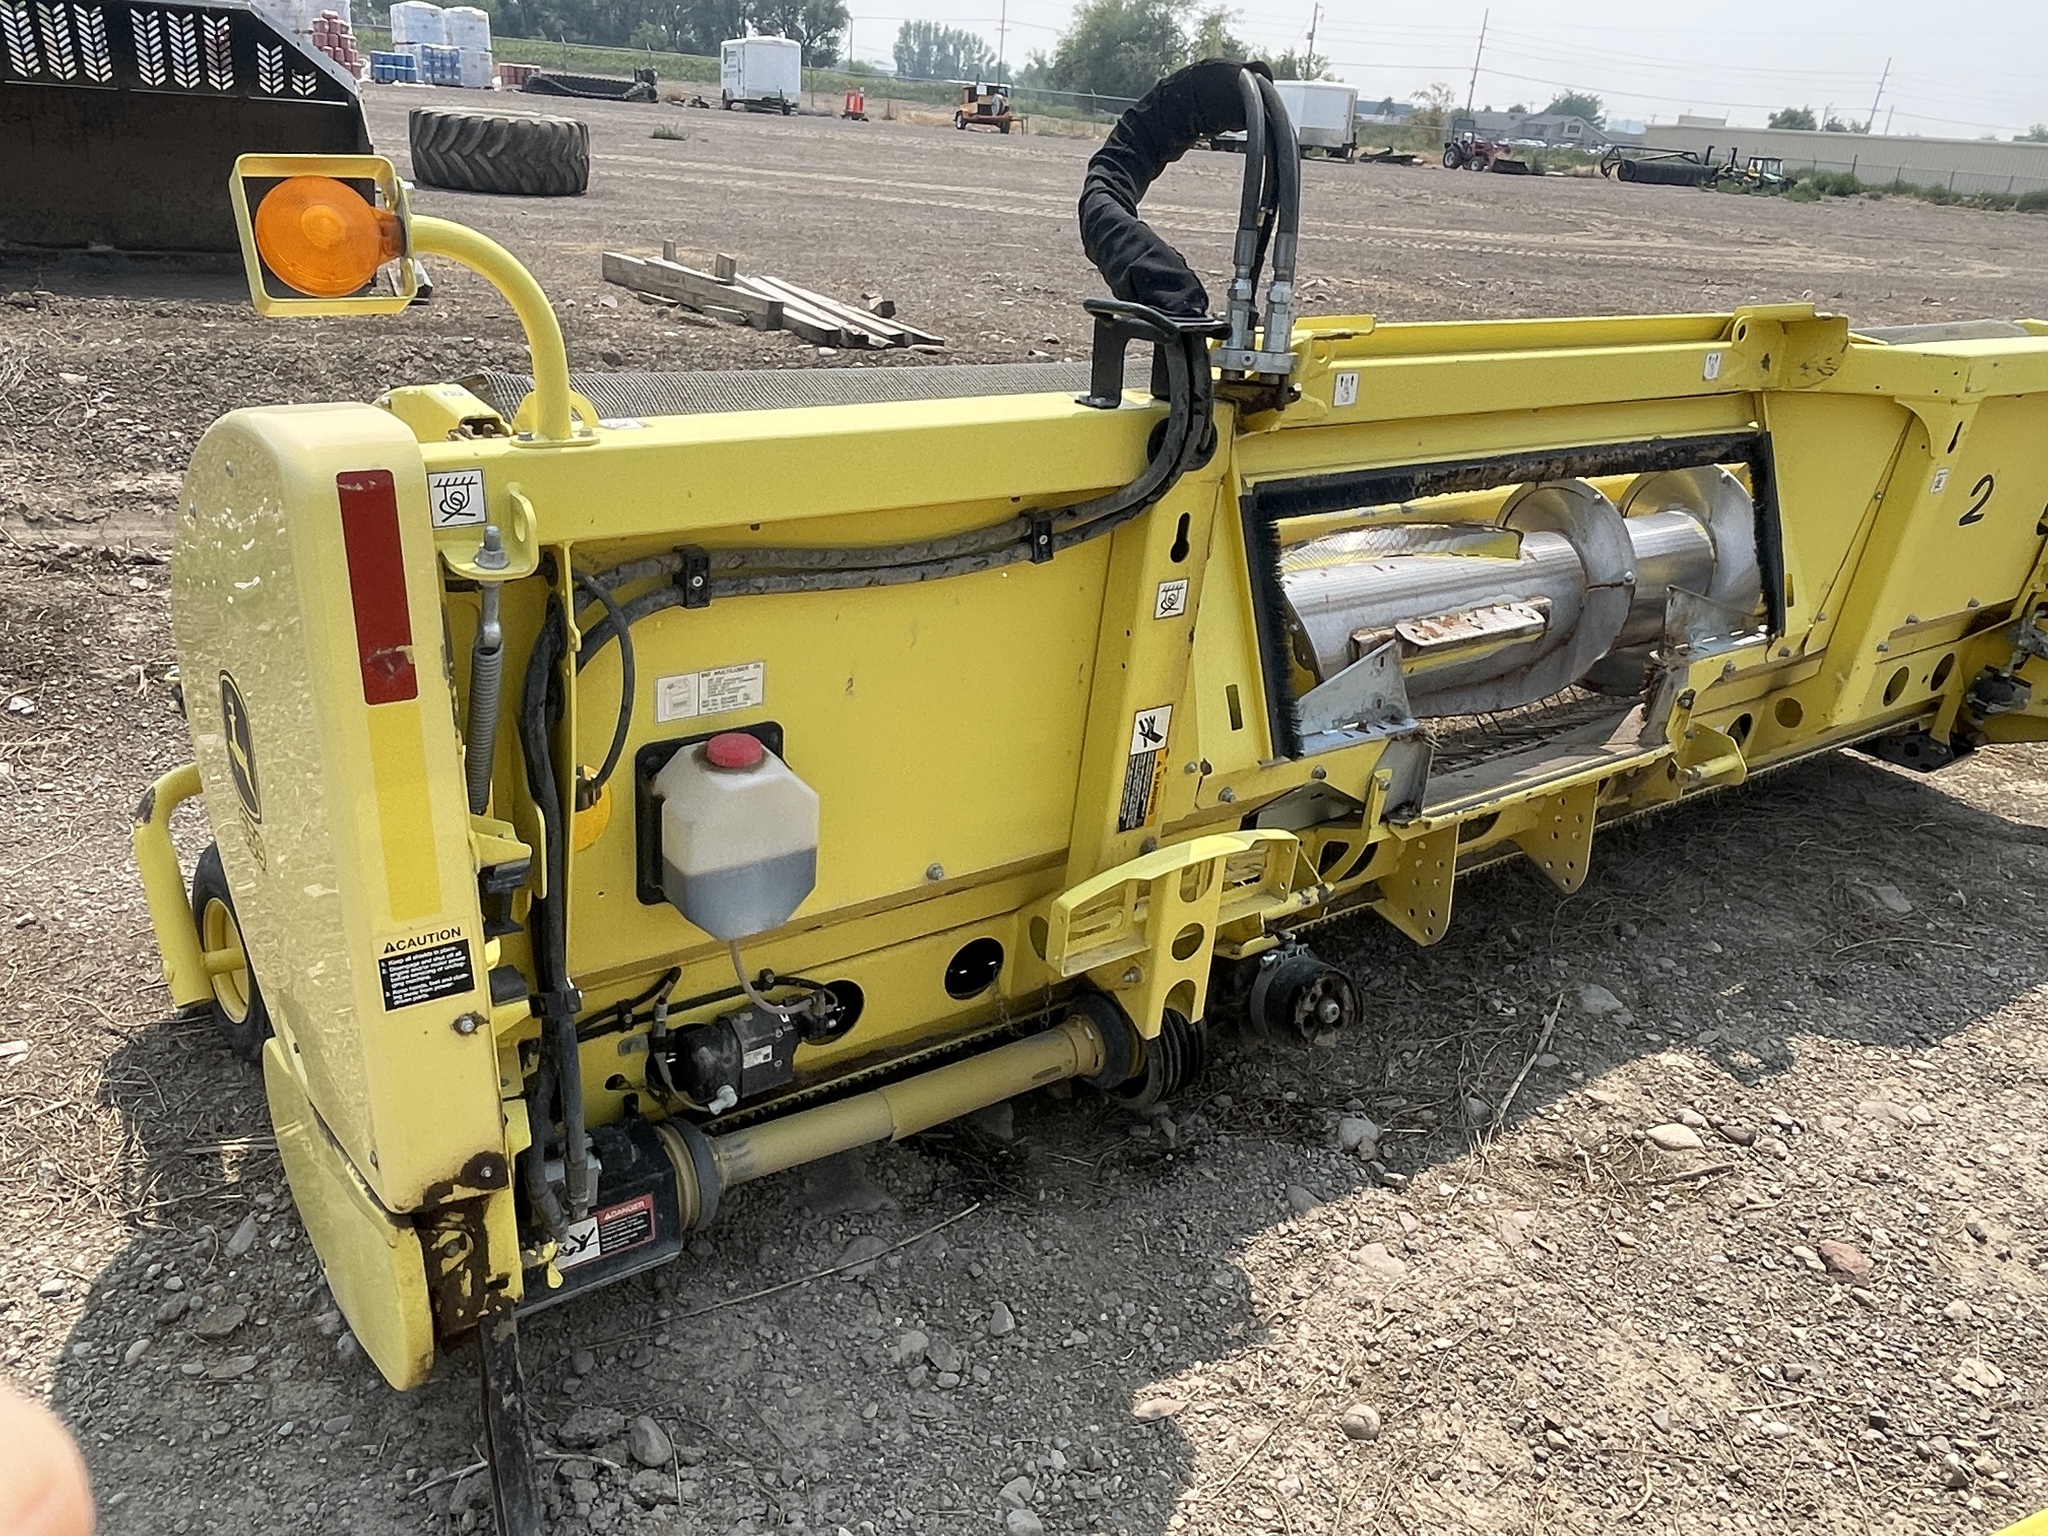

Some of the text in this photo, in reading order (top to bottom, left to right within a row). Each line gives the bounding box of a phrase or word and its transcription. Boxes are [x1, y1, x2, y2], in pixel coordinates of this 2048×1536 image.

[1958, 474, 1994, 526] 2
[396, 927, 461, 950] CAUTION
[609, 1200, 645, 1218] DANGER
